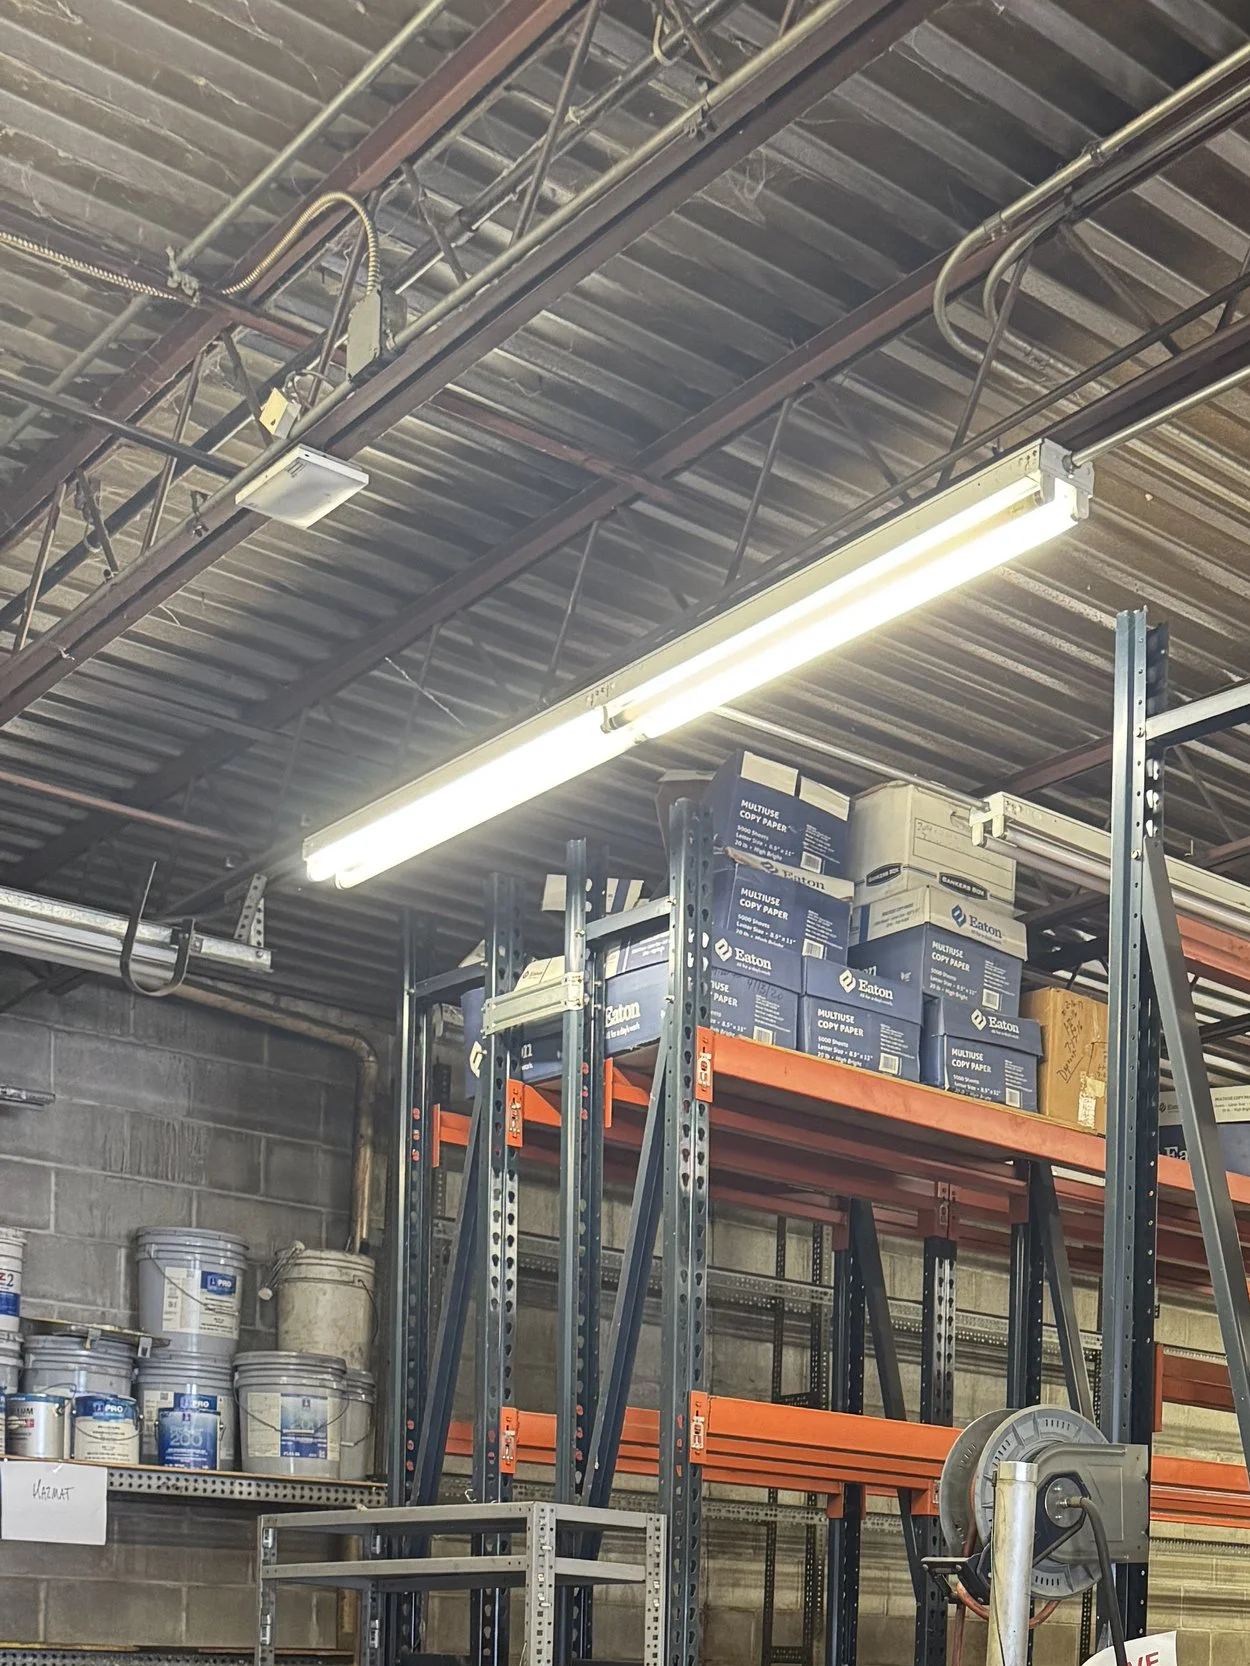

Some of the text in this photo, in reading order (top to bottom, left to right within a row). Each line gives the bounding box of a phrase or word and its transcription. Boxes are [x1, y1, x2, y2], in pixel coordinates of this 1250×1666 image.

[741, 800, 780, 819] MULTIUSE
[740, 810, 787, 833] COPY PAPER
[735, 833, 752, 843] Letter
[752, 838, 763, 846] Size
[737, 825, 769, 841] 5000 Sheets
[942, 876, 984, 896] BANKERS BOX
[741, 888, 780, 906] MULTIUSE
[740, 899, 788, 920] COPY PAPER
[736, 921, 752, 932] Letter
[753, 926, 764, 935] Size
[738, 914, 770, 929] 5000 Sheets
[969, 914, 1002, 938] Eaton
[932, 941, 964, 958] MULTIUSE
[734, 947, 772, 970] Eaton
[931, 952, 970, 972] COPY PAPER
[931, 968, 956, 981] 5000 Sheets
[858, 979, 893, 1000] Eaton
[713, 993, 738, 1006] PAPER
[605, 1002, 641, 1028] Eaton
[818, 1008, 855, 1024] MULTIUSE
[817, 1020, 864, 1037] COPY PAPER
[988, 1016, 1019, 1034] Eaton
[818, 1036, 849, 1048] 5000 Sheets
[818, 1044, 833, 1053] Letter
[833, 1047, 844, 1055] Size
[952, 1048, 984, 1061] MULTIUSE
[951, 1059, 991, 1073] COPY PAPER
[953, 1074, 979, 1085] 5000 Sheets
[217, 1280, 232, 1288] PRO
[105, 1405, 123, 1413] PRO
[170, 1432, 203, 1446] 200
